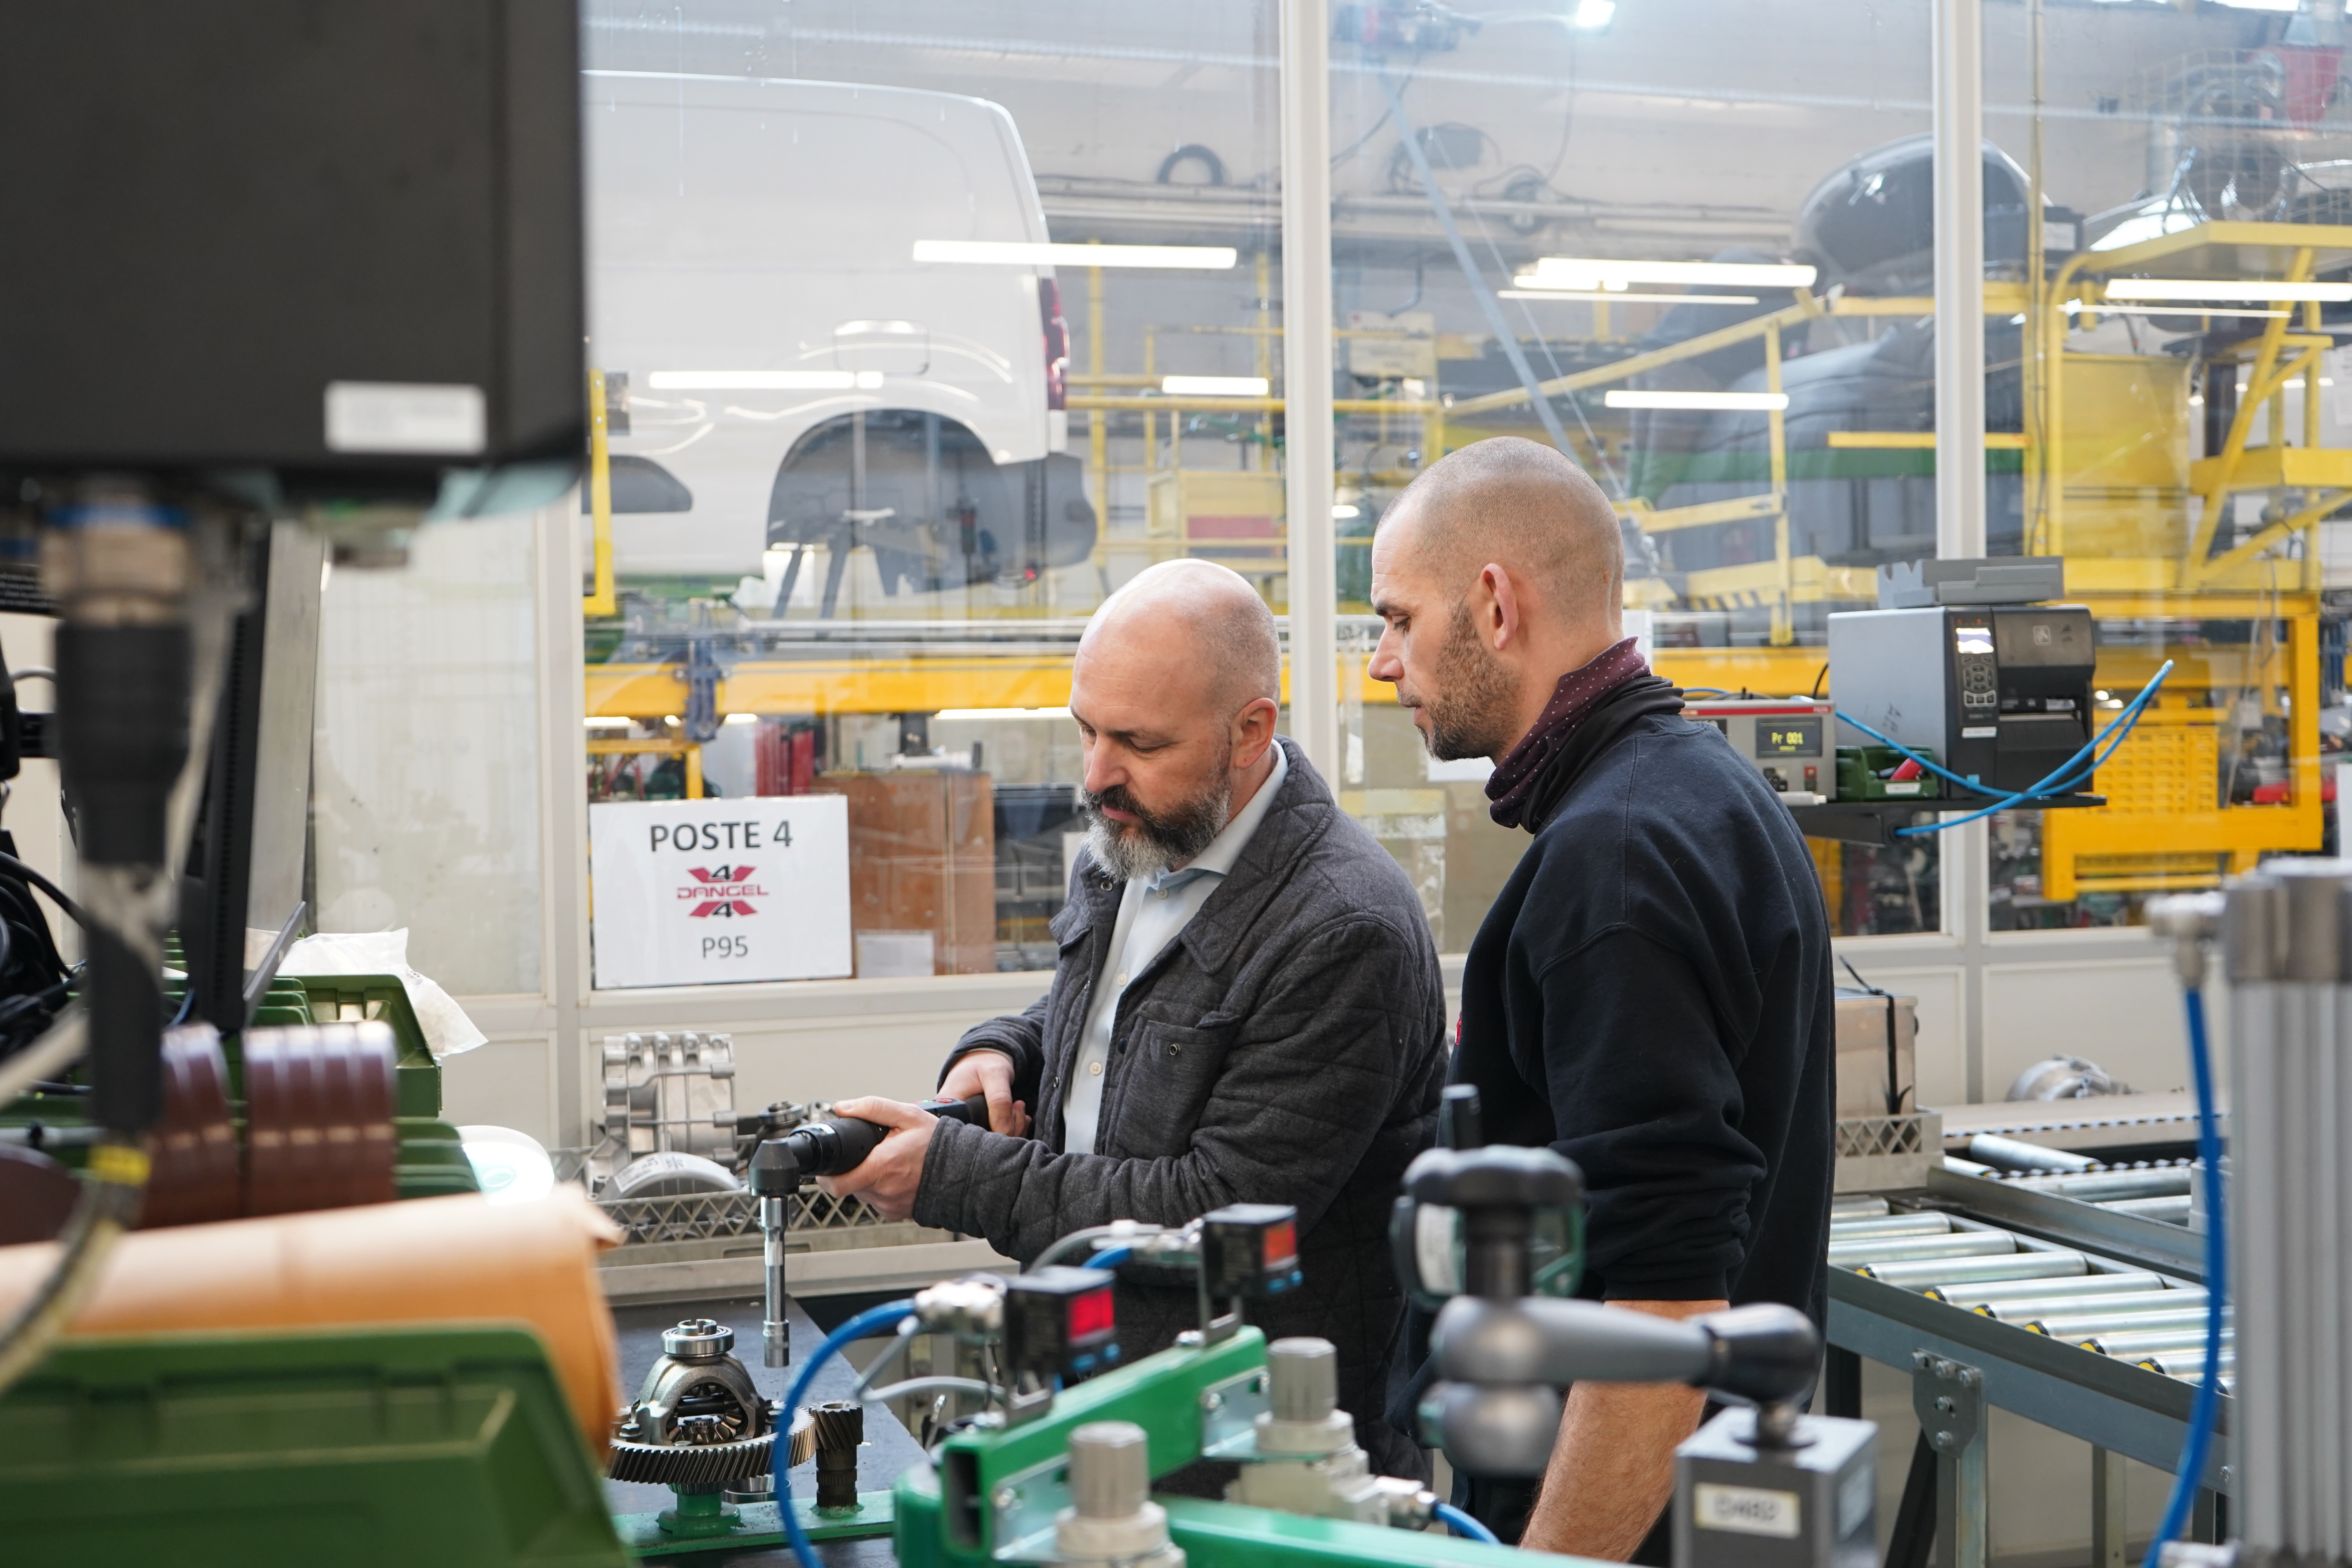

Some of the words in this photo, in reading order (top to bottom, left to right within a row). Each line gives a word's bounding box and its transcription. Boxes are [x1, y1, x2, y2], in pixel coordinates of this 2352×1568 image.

[1771, 732, 1783, 744] Pr
[1787, 732, 1803, 744] 001
[650, 821, 760, 851] POSTE
[773, 820, 793, 847] 4
[711, 864, 733, 880] 4
[677, 885, 768, 898] DANGEL
[713, 902, 733, 917] 4
[702, 936, 748, 958] P95
